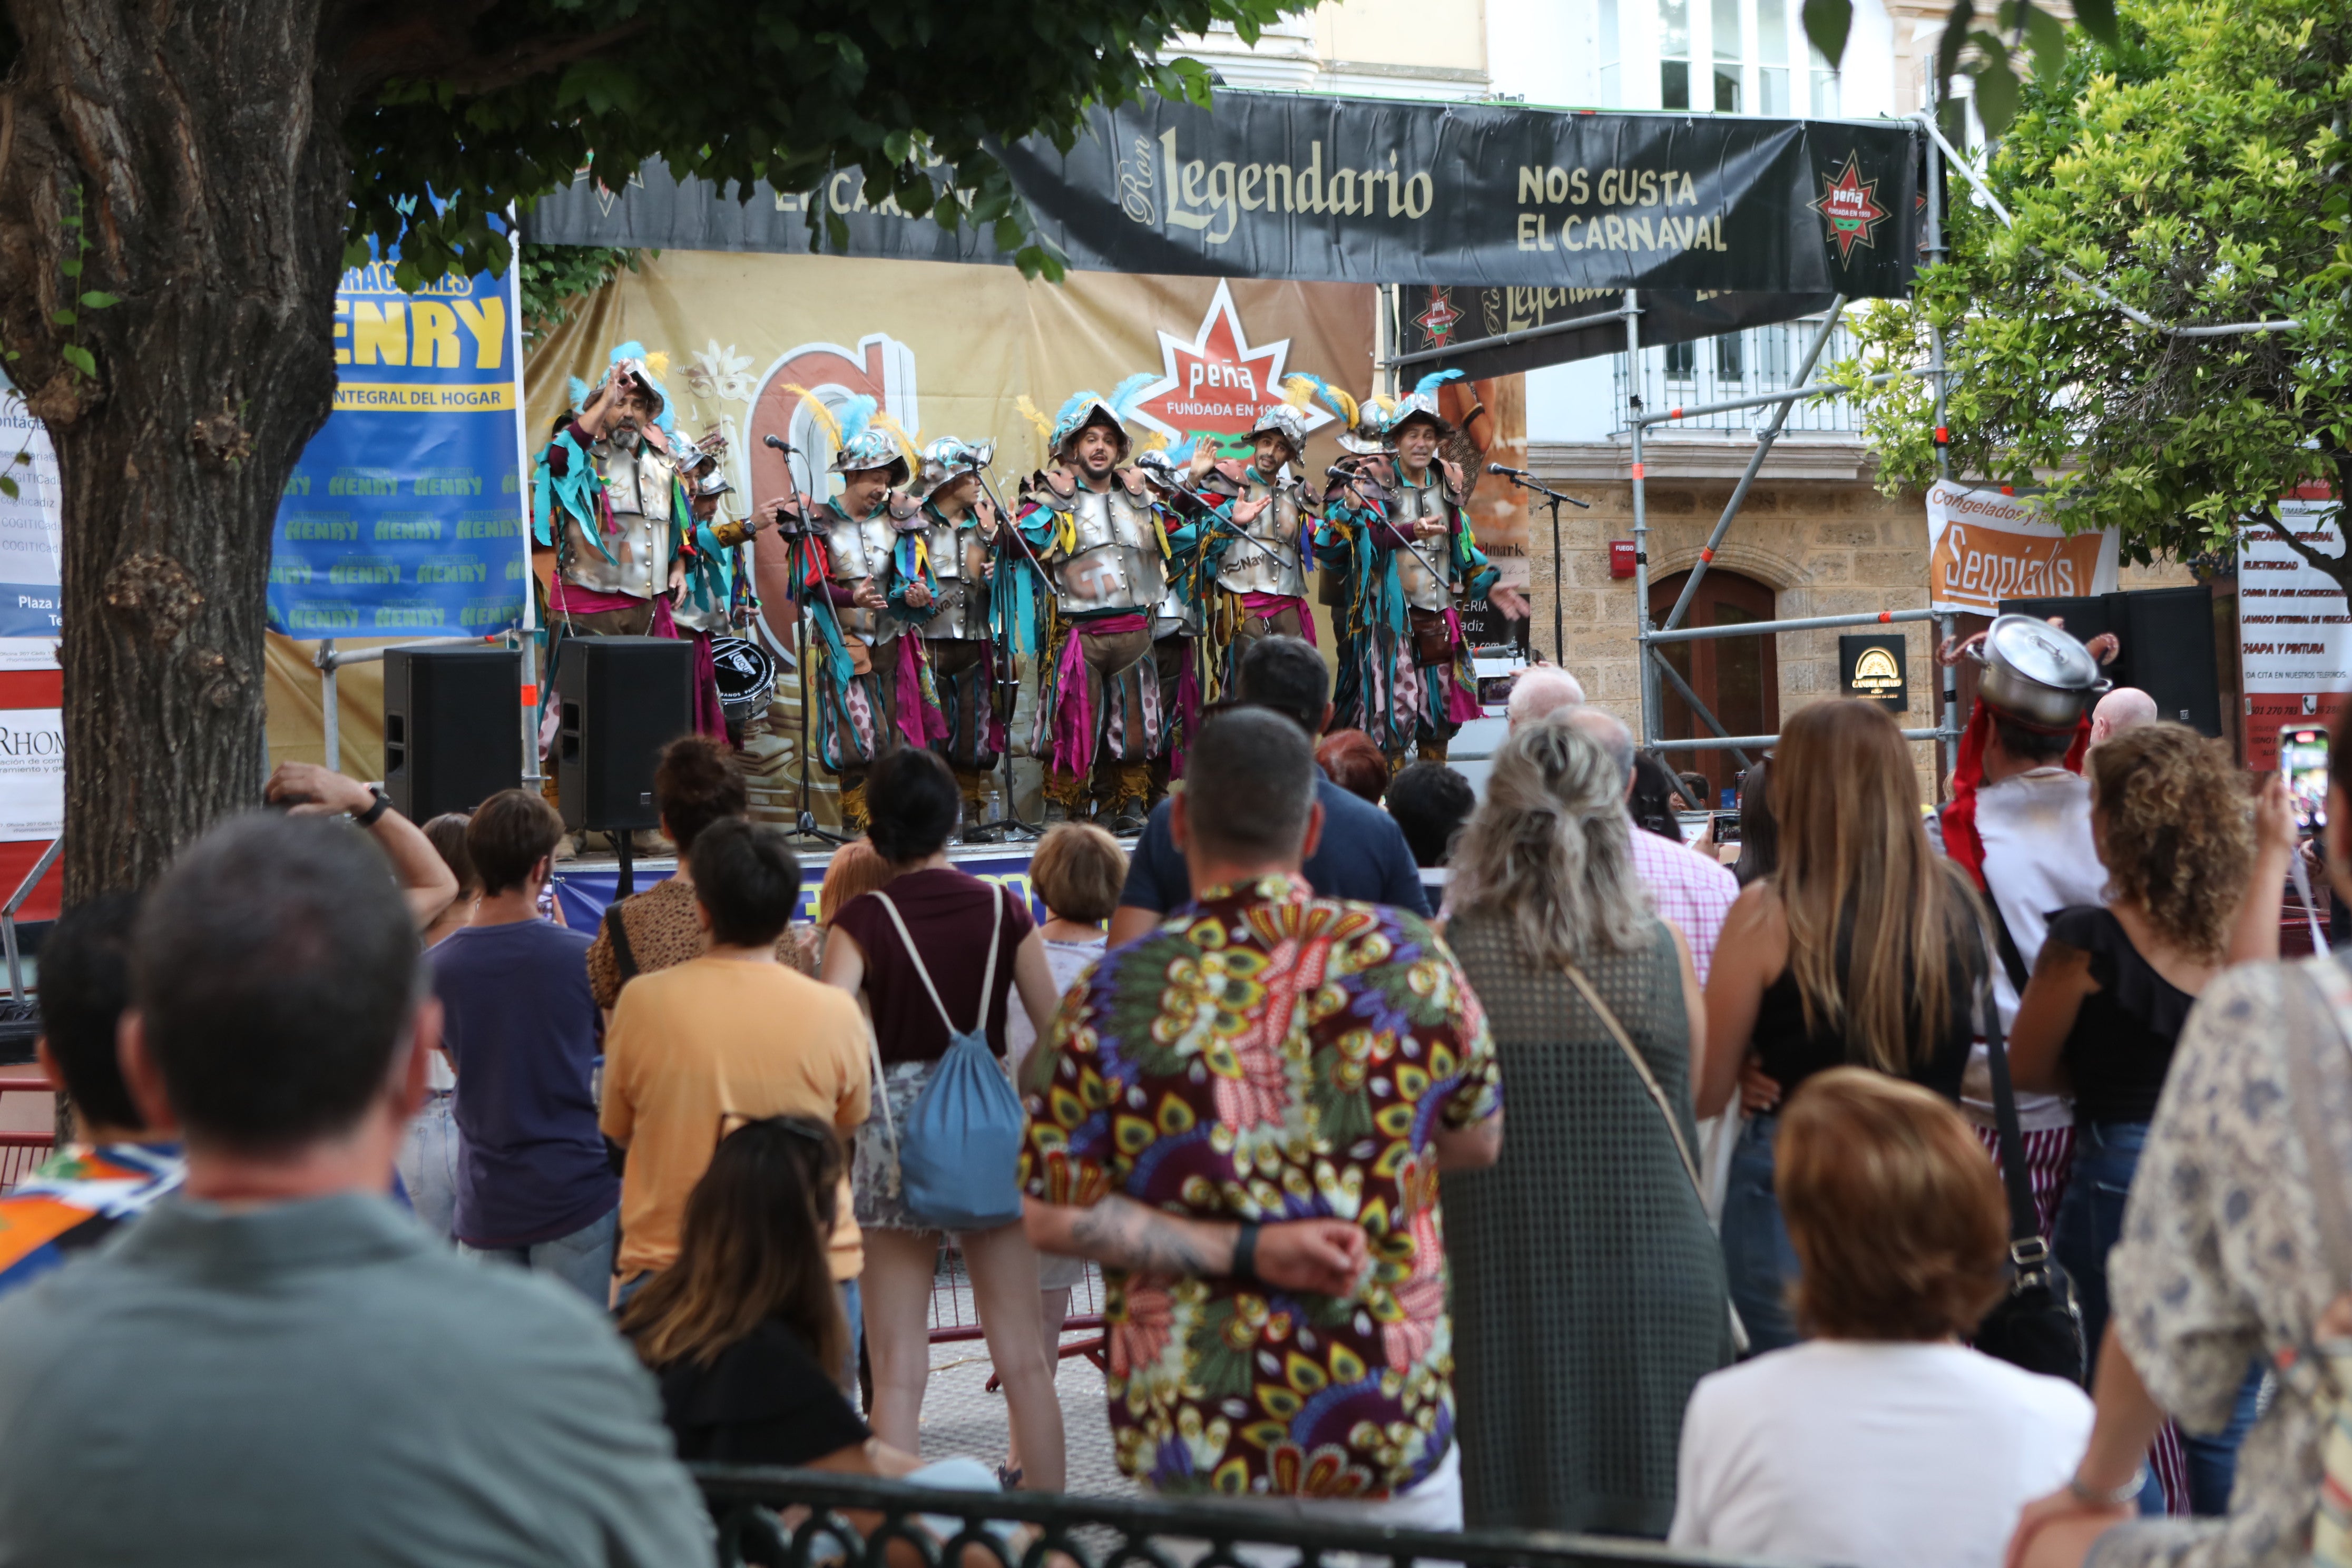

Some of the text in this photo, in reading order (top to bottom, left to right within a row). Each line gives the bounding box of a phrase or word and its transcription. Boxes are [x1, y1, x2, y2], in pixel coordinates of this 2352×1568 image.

[1118, 134, 1155, 226] Ron
[1159, 126, 1433, 244] Legendario
[1518, 166, 1698, 207] NOS GUSTA
[1833, 188, 1864, 209] peña
[1828, 208, 1849, 217] FUNDADA
[1518, 214, 1727, 252] EL CARNAVAL
[1482, 287, 1503, 336] Ro
[1189, 359, 1258, 401] peña
[410, 391, 437, 405] DEL
[442, 391, 501, 405] HOGAR
[1167, 403, 1233, 416] FUNDADA
[1236, 404, 1254, 417] EN
[329, 476, 398, 496] HENRY
[414, 476, 483, 496] HENRY
[1933, 488, 2025, 521] Congelados
[285, 520, 359, 541] HENRY
[374, 520, 442, 541] HENRY
[329, 564, 400, 584] HENRY
[417, 563, 487, 584] HENRY
[2243, 560, 2299, 571] ELECTRICIDAD
[18, 595, 53, 609] Plaza
[288, 608, 359, 629] HENRY
[375, 607, 445, 628] HENRY
[2242, 615, 2275, 624] LAVADO
[2277, 643, 2285, 654] Y
[2285, 643, 2325, 654] PINTURA
[2266, 707, 2282, 715] 270
